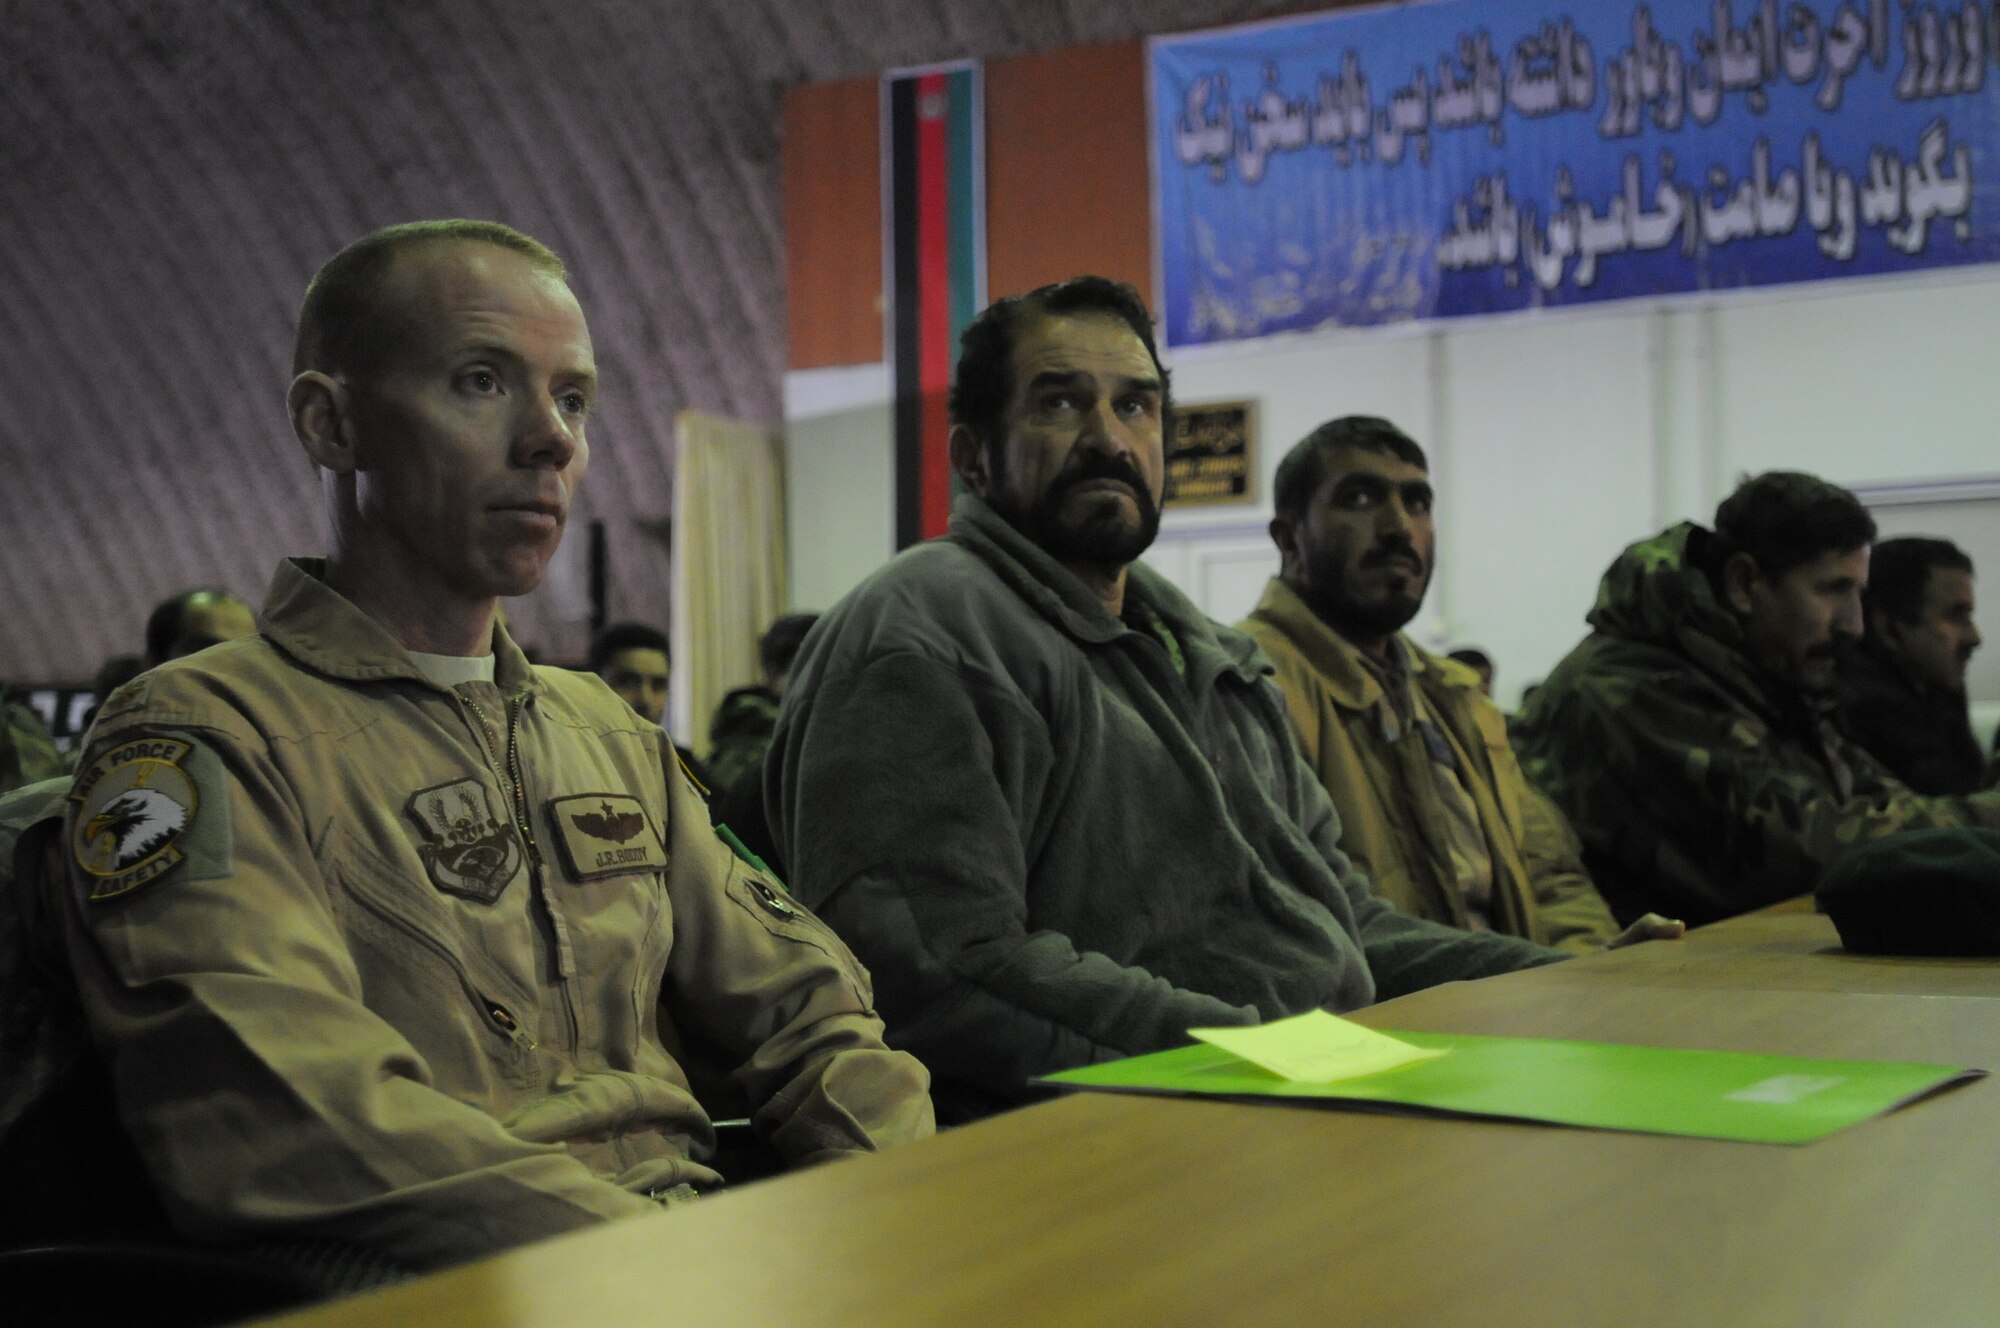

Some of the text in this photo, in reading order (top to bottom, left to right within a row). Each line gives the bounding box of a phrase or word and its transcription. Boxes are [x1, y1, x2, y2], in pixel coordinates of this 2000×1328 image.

[80, 743, 177, 796] AIR FORCE
[98, 855, 173, 893] SAFETY
